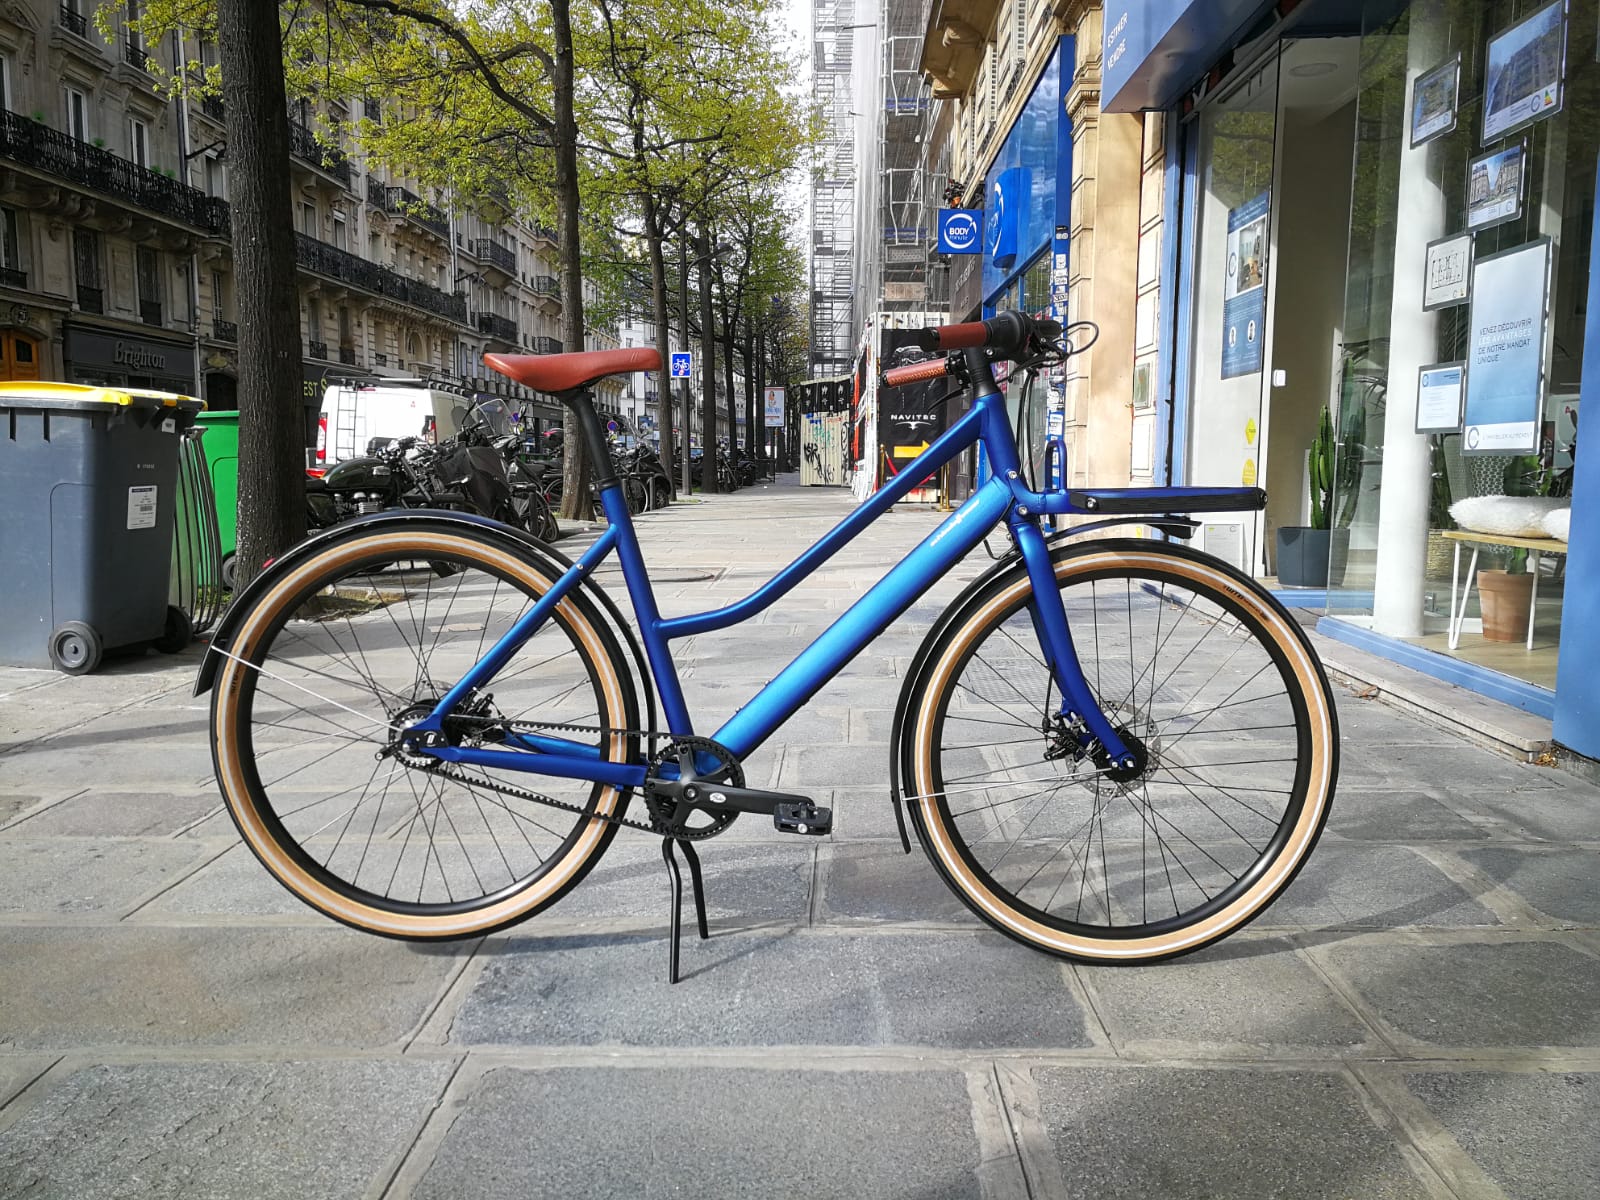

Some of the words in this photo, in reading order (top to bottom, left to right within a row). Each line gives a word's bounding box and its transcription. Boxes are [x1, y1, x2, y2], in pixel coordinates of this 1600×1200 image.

[1107, 12, 1127, 48] ESTIMER
[1107, 38, 1126, 71] VENDRE
[949, 227, 970, 235] BODY
[1480, 325, 1497, 336] VENEZ
[1493, 328, 1532, 342] AVANTAGES
[1486, 342, 1506, 353] NOTRE
[1506, 338, 1531, 349] MANDAT
[115, 341, 166, 369] Brighton
[1478, 354, 1499, 365] UNIQUE
